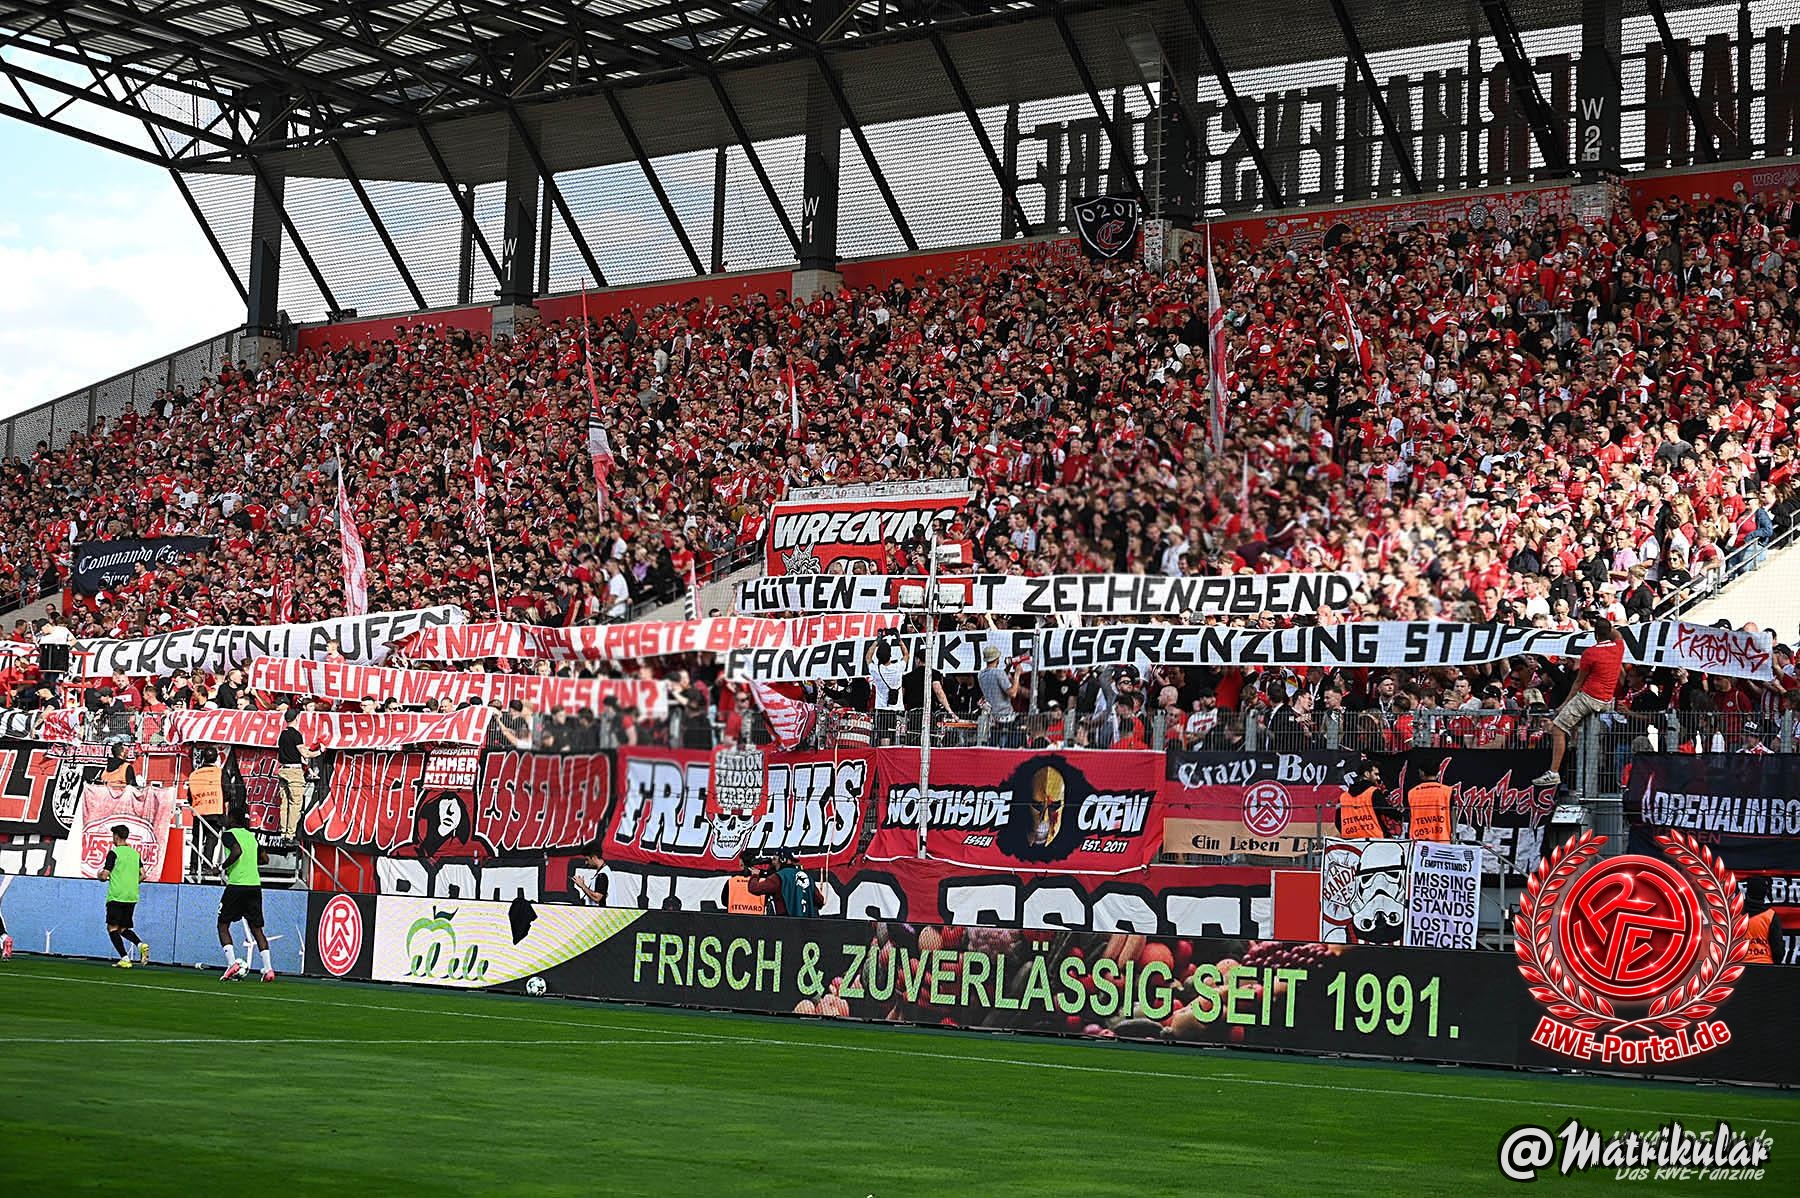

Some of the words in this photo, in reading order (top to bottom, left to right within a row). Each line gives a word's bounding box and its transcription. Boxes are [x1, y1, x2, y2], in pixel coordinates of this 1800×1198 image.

[1581, 97, 1604, 121] W
[1584, 125, 1602, 152] 2
[803, 196, 820, 217] W
[1082, 203, 1133, 222] 0201
[805, 221, 814, 243] 1
[503, 238, 519, 257] W
[504, 260, 513, 281] 1
[79, 546, 154, 575] Commando
[740, 574, 1007, 612] HÜTTEN-ST
[1022, 574, 1353, 614] ZECHENABEND
[446, 622, 512, 659] NOCH
[580, 626, 601, 660] &
[604, 619, 701, 660] PASTE
[705, 616, 786, 651] BEIM
[790, 612, 901, 647] VEREIN
[1010, 622, 1380, 666] AUSGRENZUNG
[1403, 620, 1671, 664] STOPPEN!
[251, 655, 318, 694] FÄLLT
[324, 663, 396, 704] EUCH
[401, 669, 486, 710] NICHTS
[491, 674, 593, 716] EIGENES
[599, 678, 660, 715] EIN?
[340, 706, 487, 748] ERHALTEN!
[425, 756, 478, 773] IMMER
[424, 771, 449, 785] MIT
[448, 773, 475, 786] UNS!
[715, 769, 763, 788] STADION
[304, 750, 424, 849] JUNGE
[477, 752, 610, 850] ESSENER
[716, 786, 762, 805] VERBOT
[1641, 772, 1768, 834] ADRENALIN
[886, 788, 1014, 827] NORTHSIDE
[1077, 792, 1149, 833] CREW
[963, 834, 993, 848] ESSEN
[1081, 839, 1102, 852] EST.
[1103, 840, 1129, 853] 2011
[1191, 835, 1220, 850] Ein
[1230, 837, 1280, 852] Leben
[1424, 859, 1444, 869] EMPTY
[1443, 861, 1468, 873] STANDS
[1322, 866, 1358, 902] BANDA
[1414, 872, 1476, 891] MISSING
[1413, 886, 1448, 900] FROM
[1452, 890, 1475, 903] THE
[1412, 899, 1475, 918] STANDS
[1411, 915, 1449, 930] LOST
[1453, 921, 1474, 936] TO
[633, 932, 783, 993] FRISCH
[797, 942, 825, 999] &
[839, 940, 1173, 1020] ZUVERLÄSSIG
[1193, 963, 1308, 1028] SEIT
[1327, 971, 1460, 1039] 1991.
